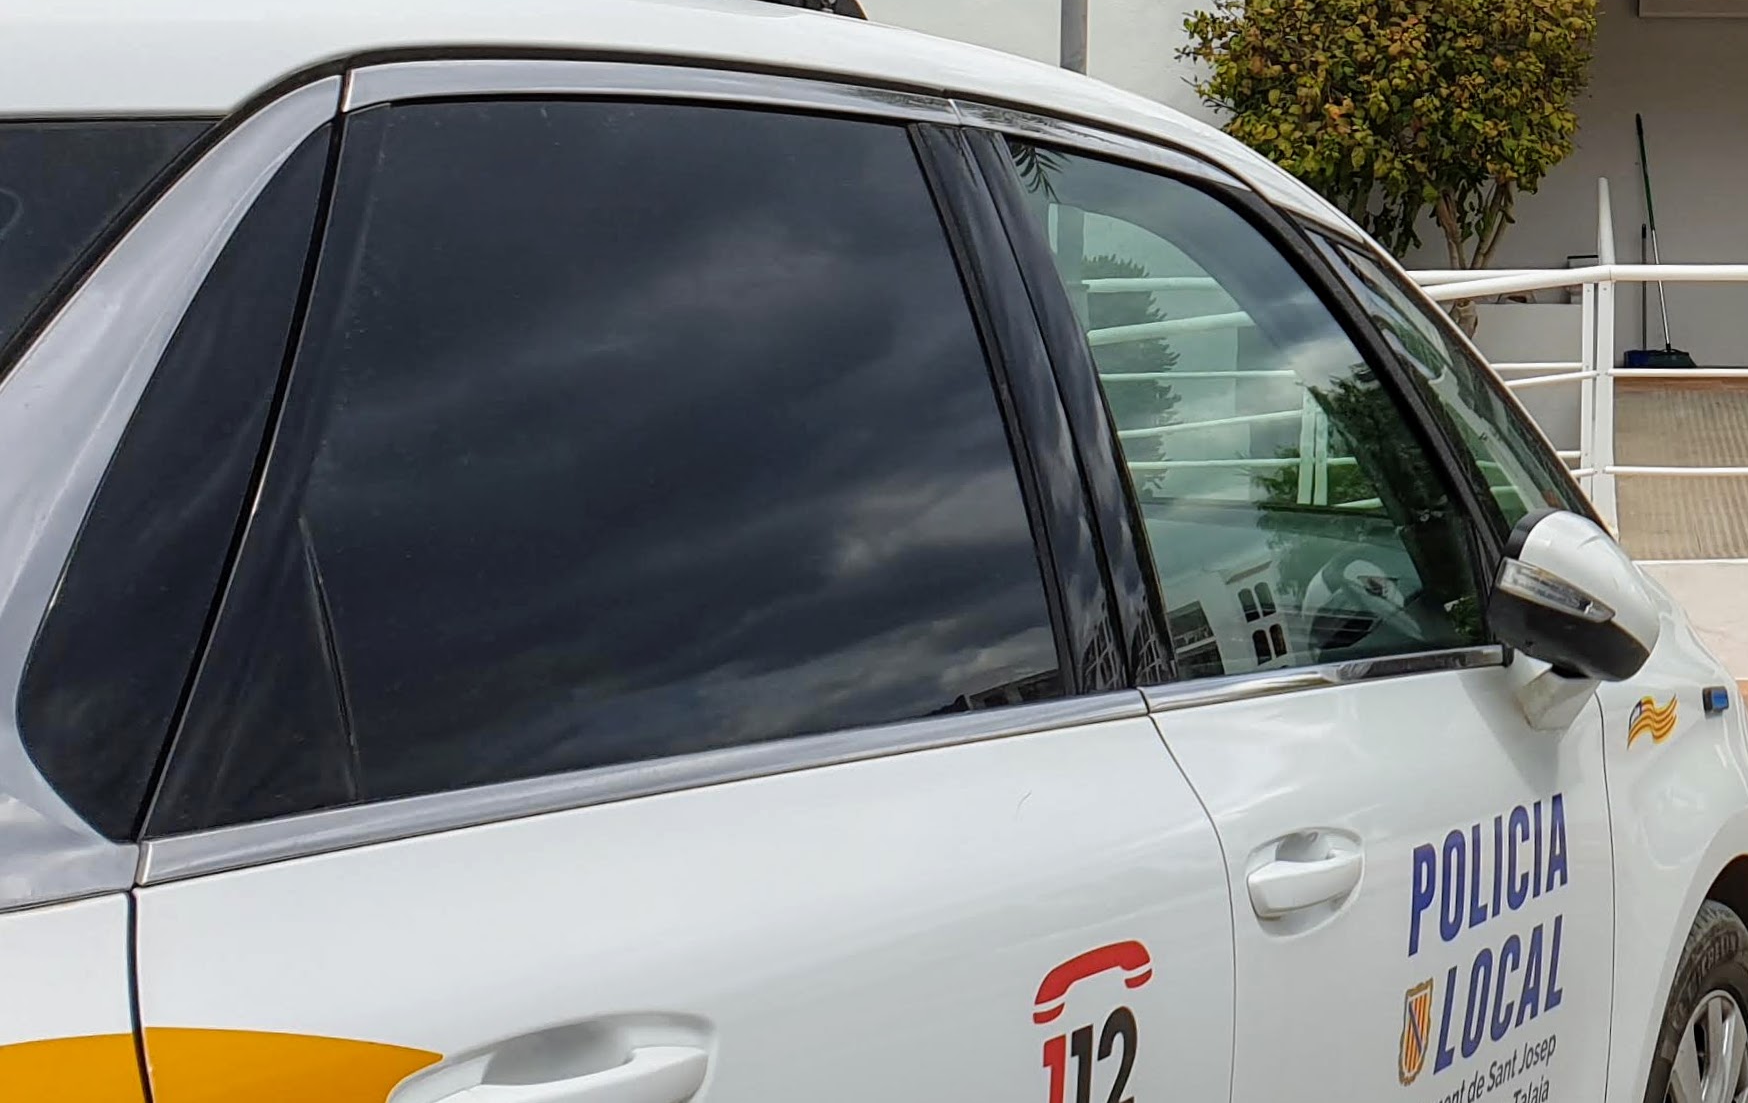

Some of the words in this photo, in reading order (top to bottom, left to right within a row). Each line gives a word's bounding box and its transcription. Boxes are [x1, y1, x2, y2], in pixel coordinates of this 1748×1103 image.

[1408, 793, 1568, 957] POLICIA
[1043, 1006, 1138, 1103] 112
[1433, 914, 1563, 1075] LOCAL
[1467, 1070, 1485, 1103] de
[1487, 1049, 1517, 1092] Sant
[1518, 1034, 1556, 1075] Josep
